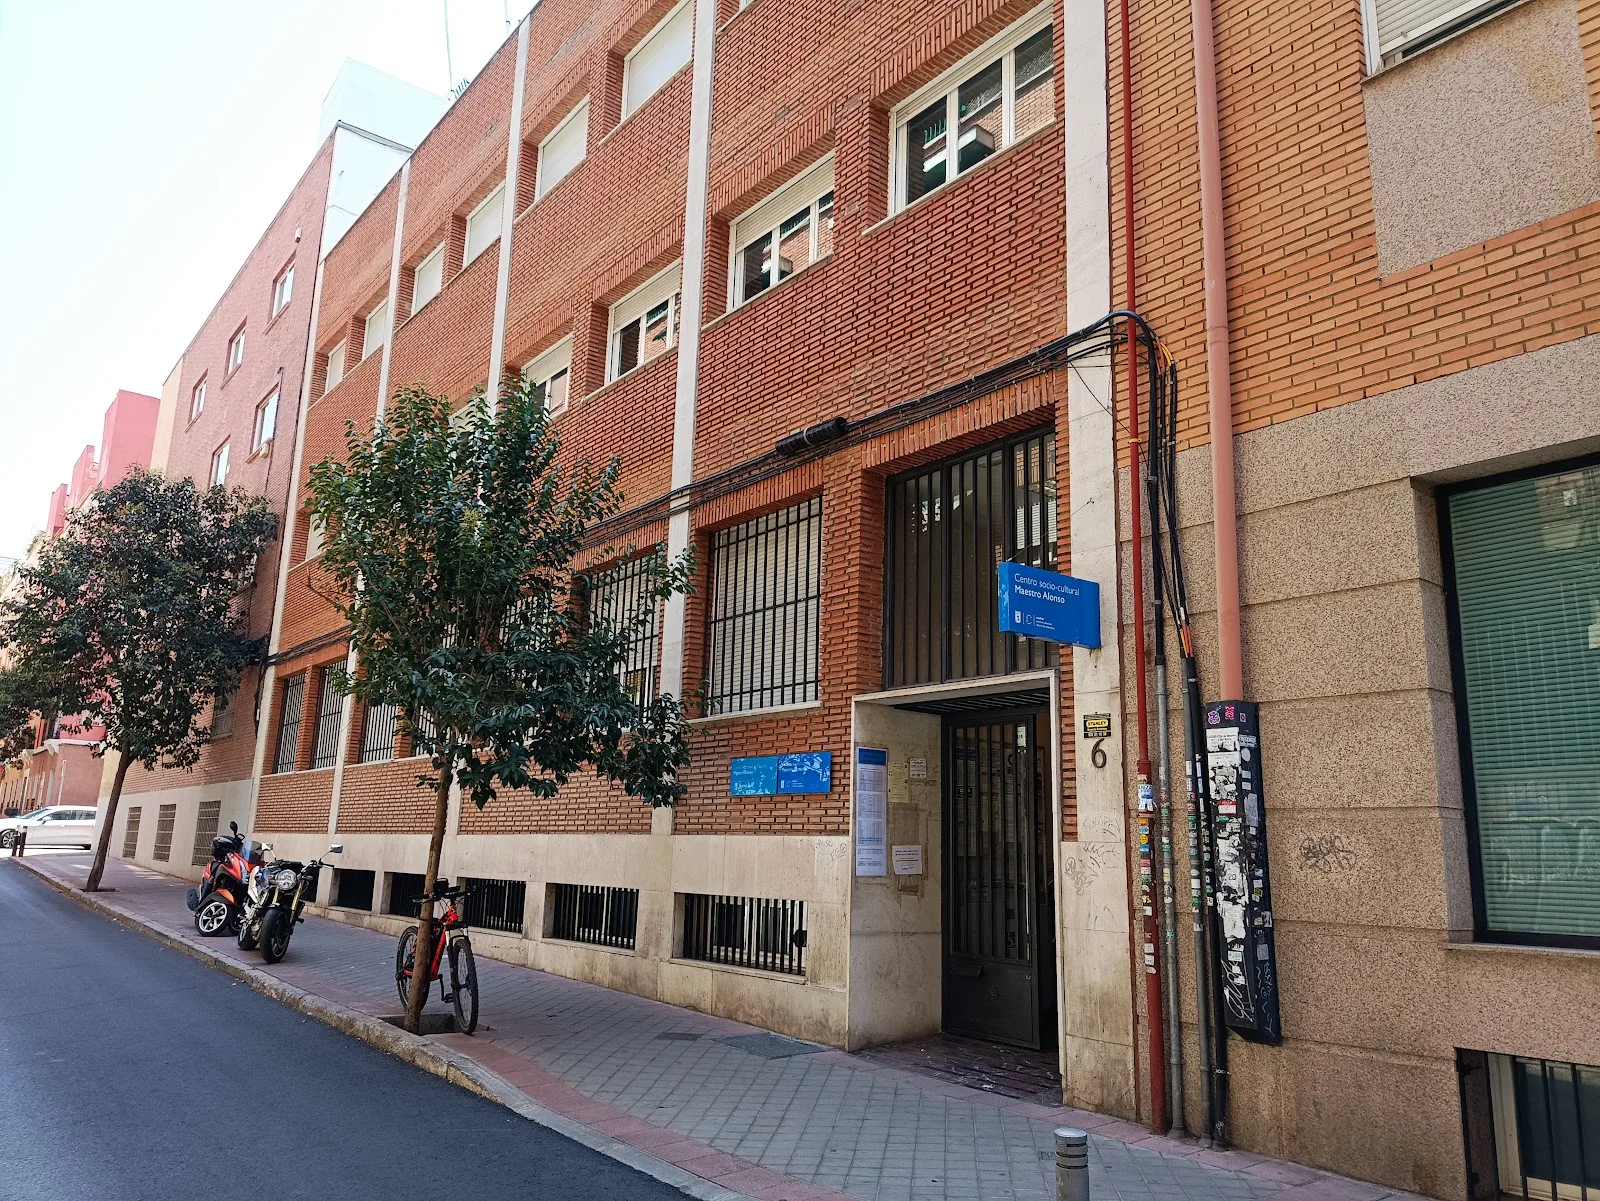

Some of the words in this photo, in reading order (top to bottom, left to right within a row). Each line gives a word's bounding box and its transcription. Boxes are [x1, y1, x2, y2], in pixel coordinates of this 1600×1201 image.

[1014, 573, 1037, 586] Centro
[1039, 580, 1079, 596] socio-cultural
[1014, 584, 1042, 598] Maestro
[1042, 591, 1065, 604] Alonso
[1091, 738, 1107, 768] 6
